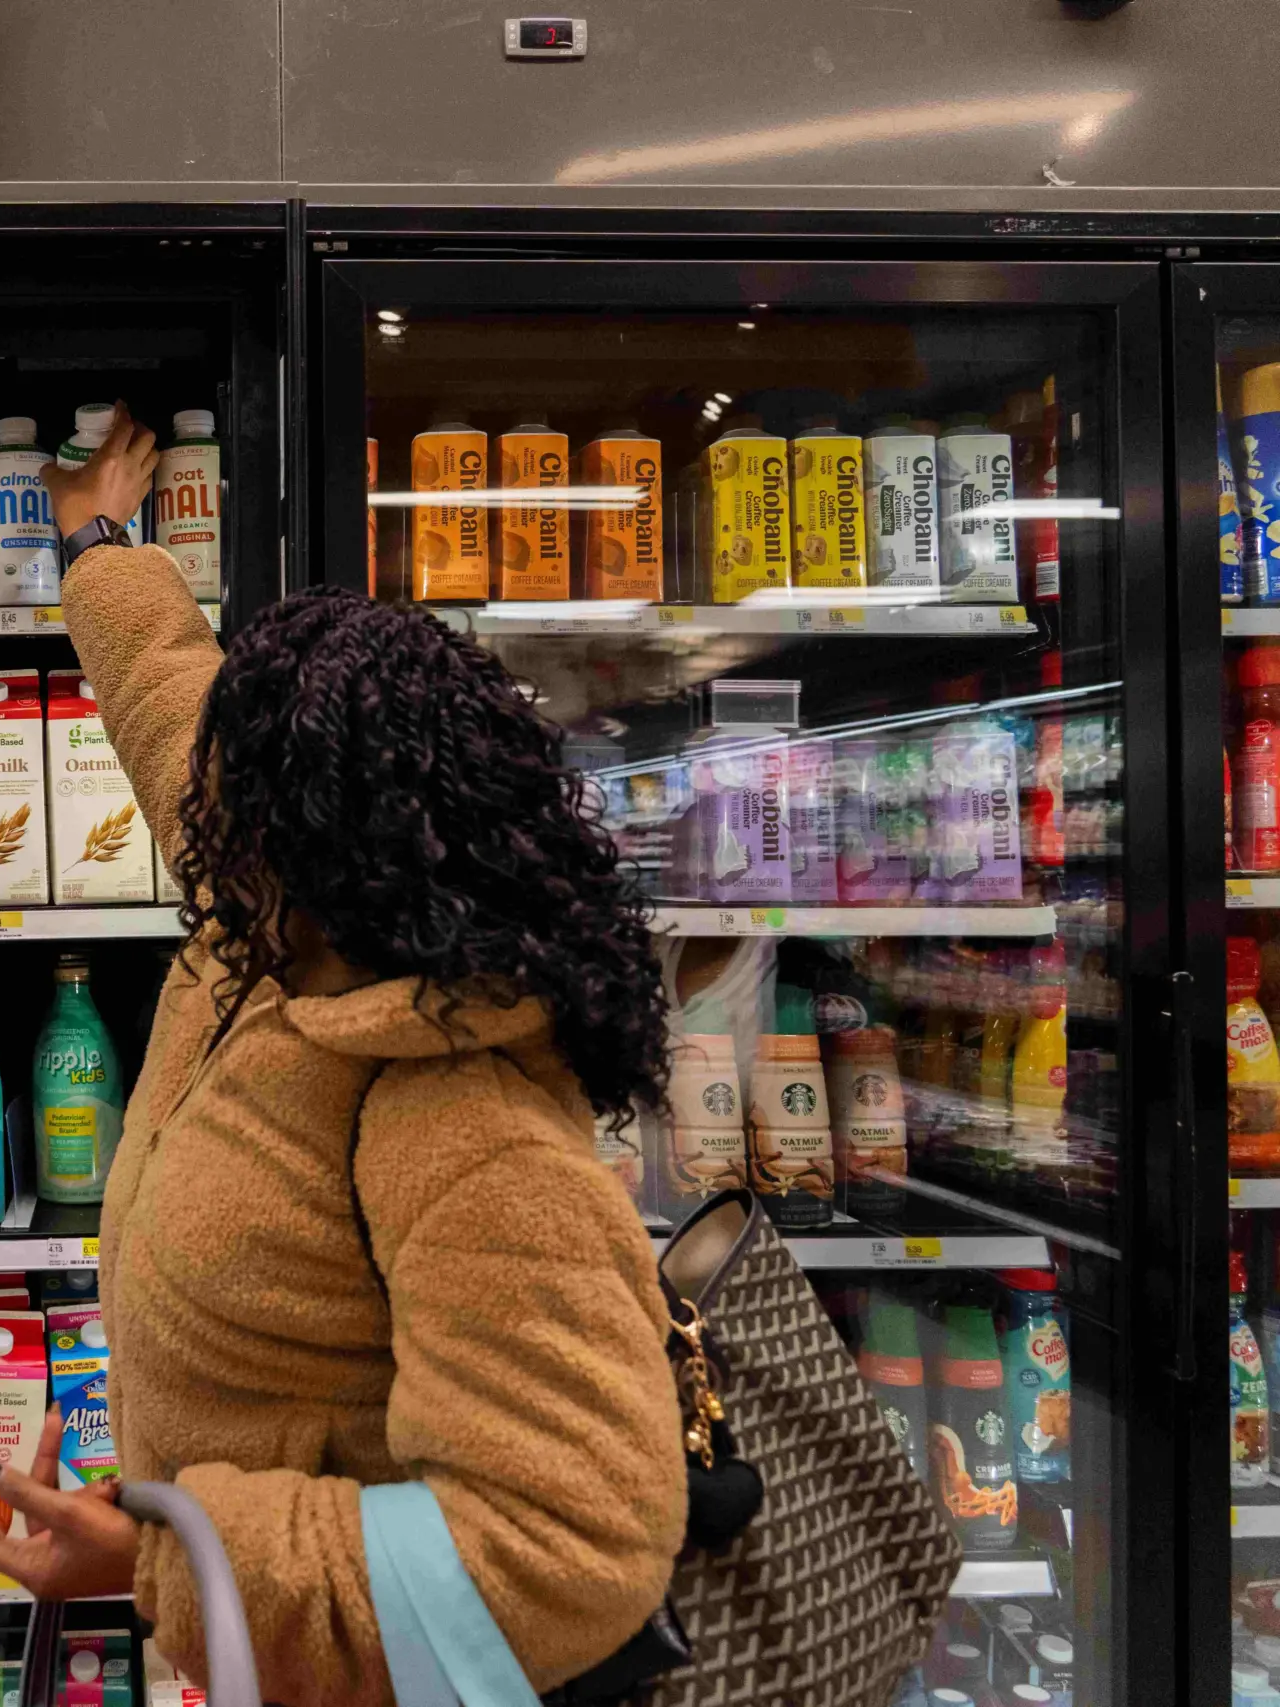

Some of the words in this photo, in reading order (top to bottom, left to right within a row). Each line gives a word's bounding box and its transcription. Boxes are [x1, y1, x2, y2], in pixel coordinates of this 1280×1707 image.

[173, 468, 204, 481] oat
[156, 485, 219, 525] MAL
[763, 457, 786, 562] Chobani
[837, 456, 860, 561] Chobani
[903, 496, 911, 526] Coffee
[913, 456, 936, 562] Chobani
[172, 532, 211, 542] ORIGINAL
[0, 738, 23, 746] Based
[1227, 1023, 1265, 1040] Coffee
[39, 1047, 101, 1076] ripple
[852, 1128, 895, 1136] OATMILK
[55, 1363, 73, 1371] 50%
